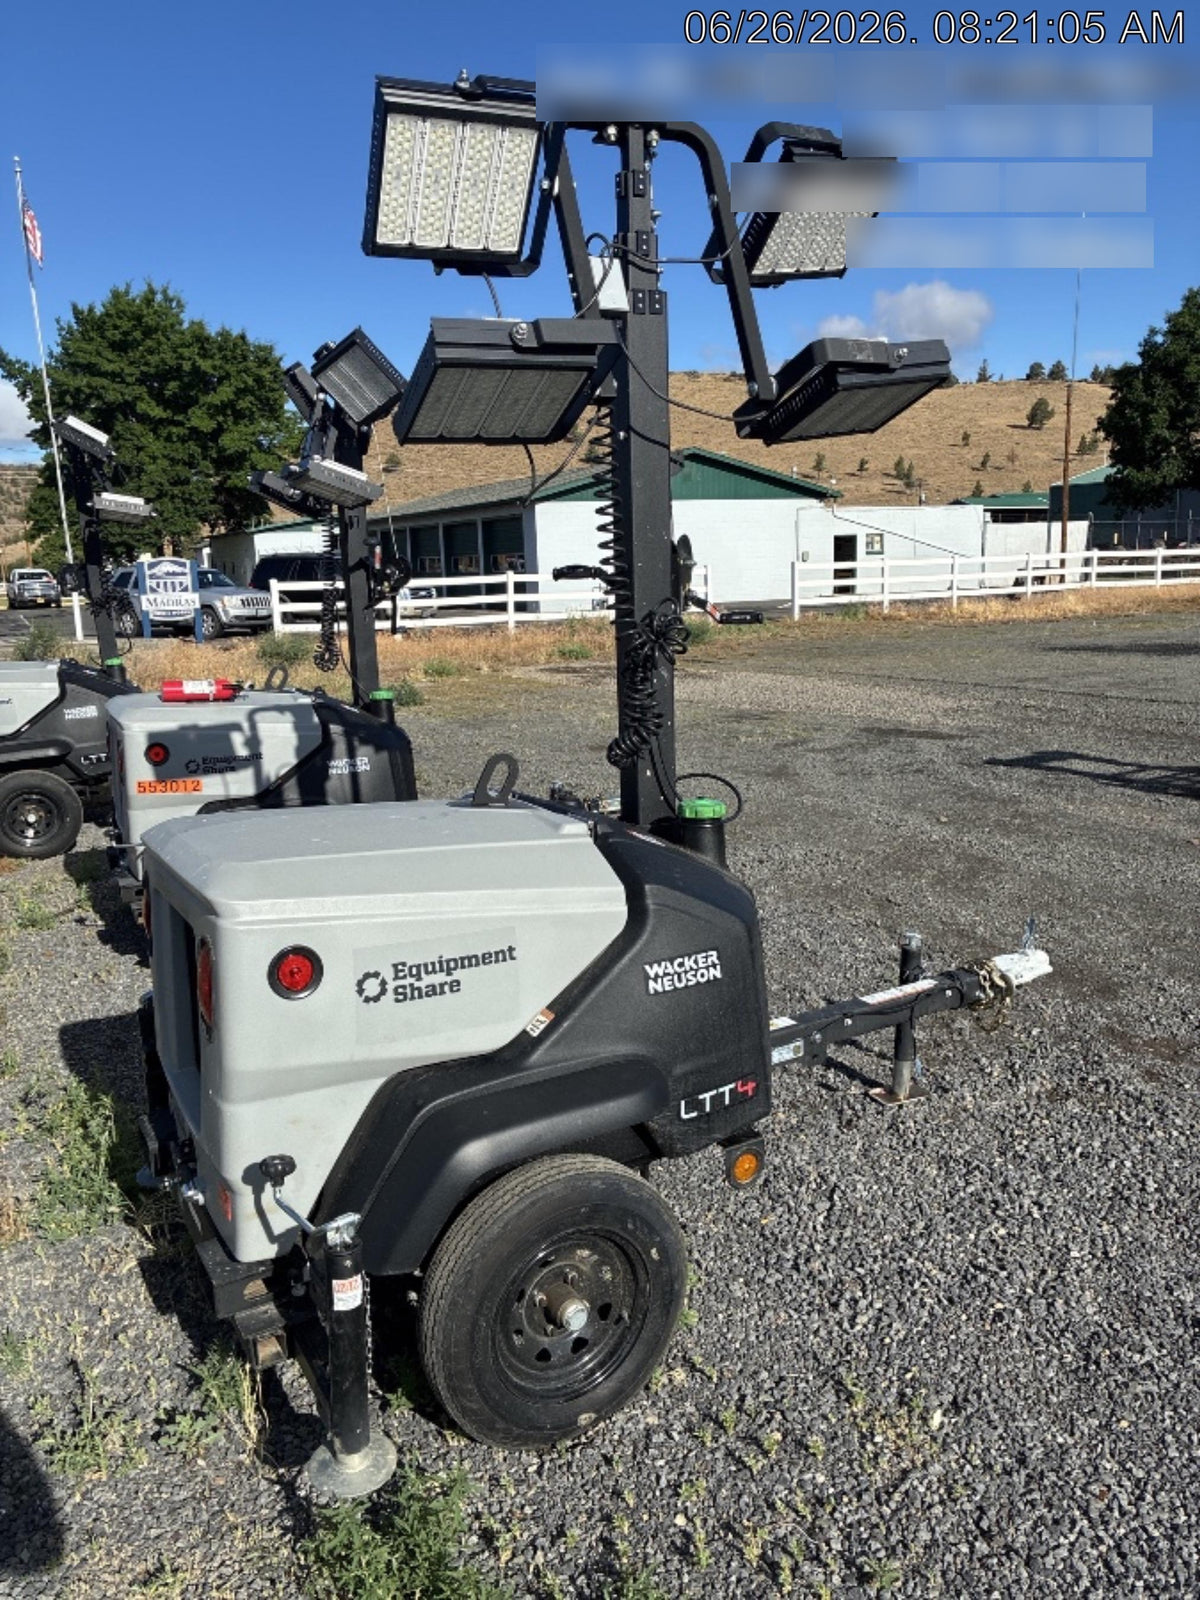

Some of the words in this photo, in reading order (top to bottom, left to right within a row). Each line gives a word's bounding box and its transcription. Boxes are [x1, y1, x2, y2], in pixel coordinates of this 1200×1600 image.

[81, 753, 107, 765] LTT
[137, 780, 200, 793] 553012
[391, 945, 516, 981] Equipment
[643, 950, 719, 977] WACKER
[392, 976, 462, 1003] Share
[648, 967, 721, 994] NEUSON
[679, 1079, 756, 1119] LTT4
